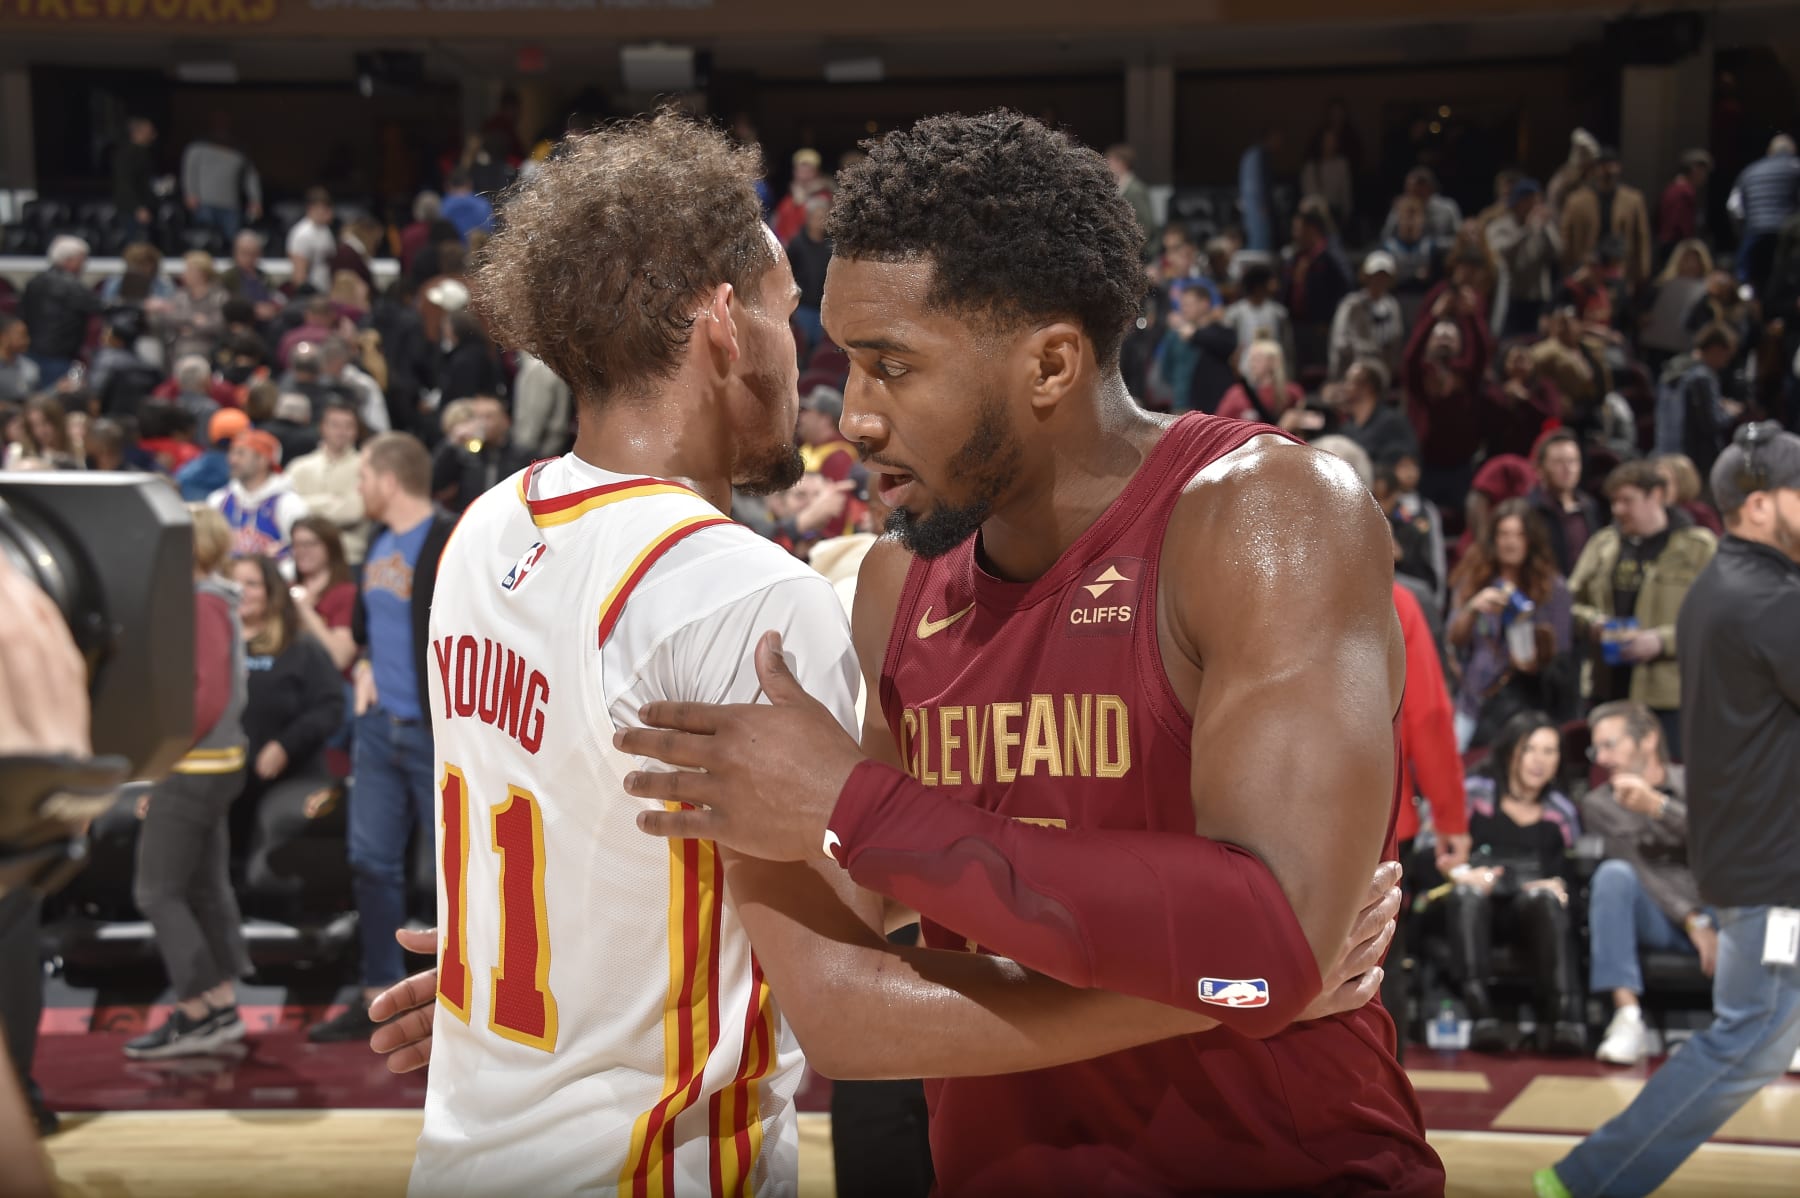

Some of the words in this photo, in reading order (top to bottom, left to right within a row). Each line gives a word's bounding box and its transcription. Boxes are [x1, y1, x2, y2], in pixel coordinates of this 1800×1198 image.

[1070, 605, 1131, 624] CLIFFS
[433, 635, 549, 755] YOUNG
[901, 693, 1131, 786] CLEVEAND
[437, 762, 559, 1053] 11
